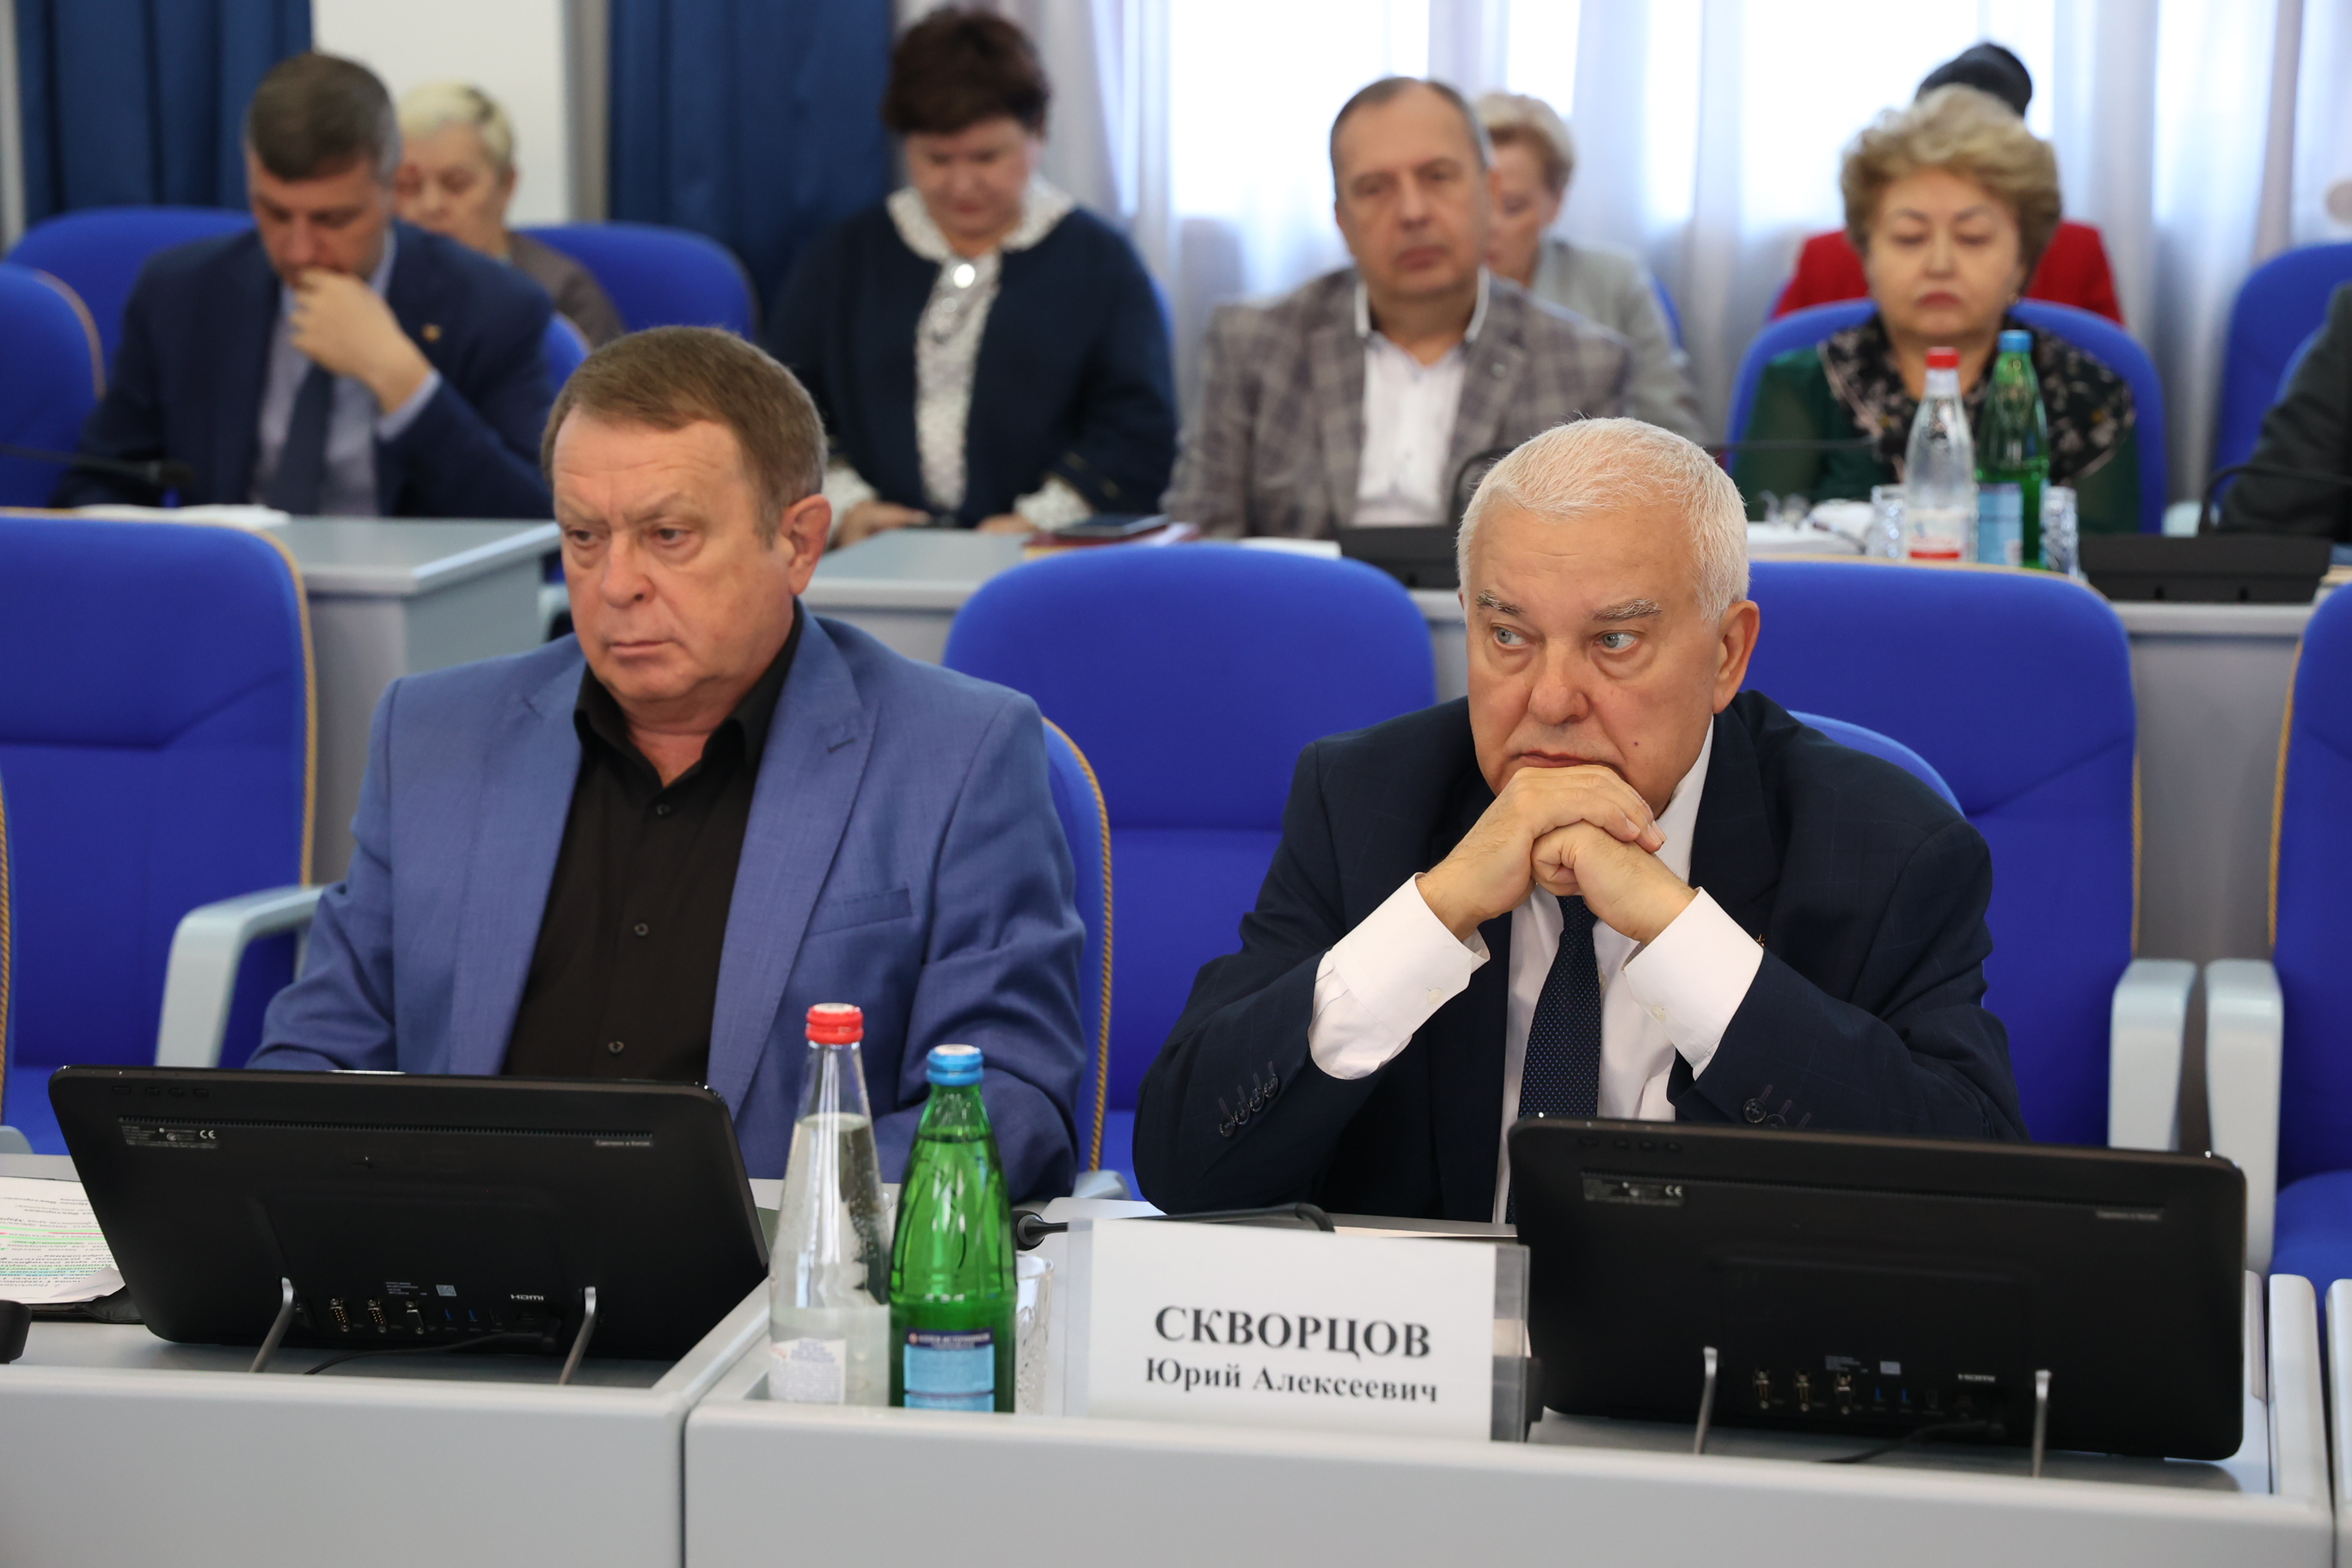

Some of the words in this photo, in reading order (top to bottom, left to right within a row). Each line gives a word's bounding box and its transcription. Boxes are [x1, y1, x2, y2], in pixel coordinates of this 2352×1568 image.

[1155, 1306, 1431, 1362] СКВОРЦОВ
[1146, 1357, 1241, 1393] Юрий
[1253, 1368, 1438, 1404] Алексеевич
